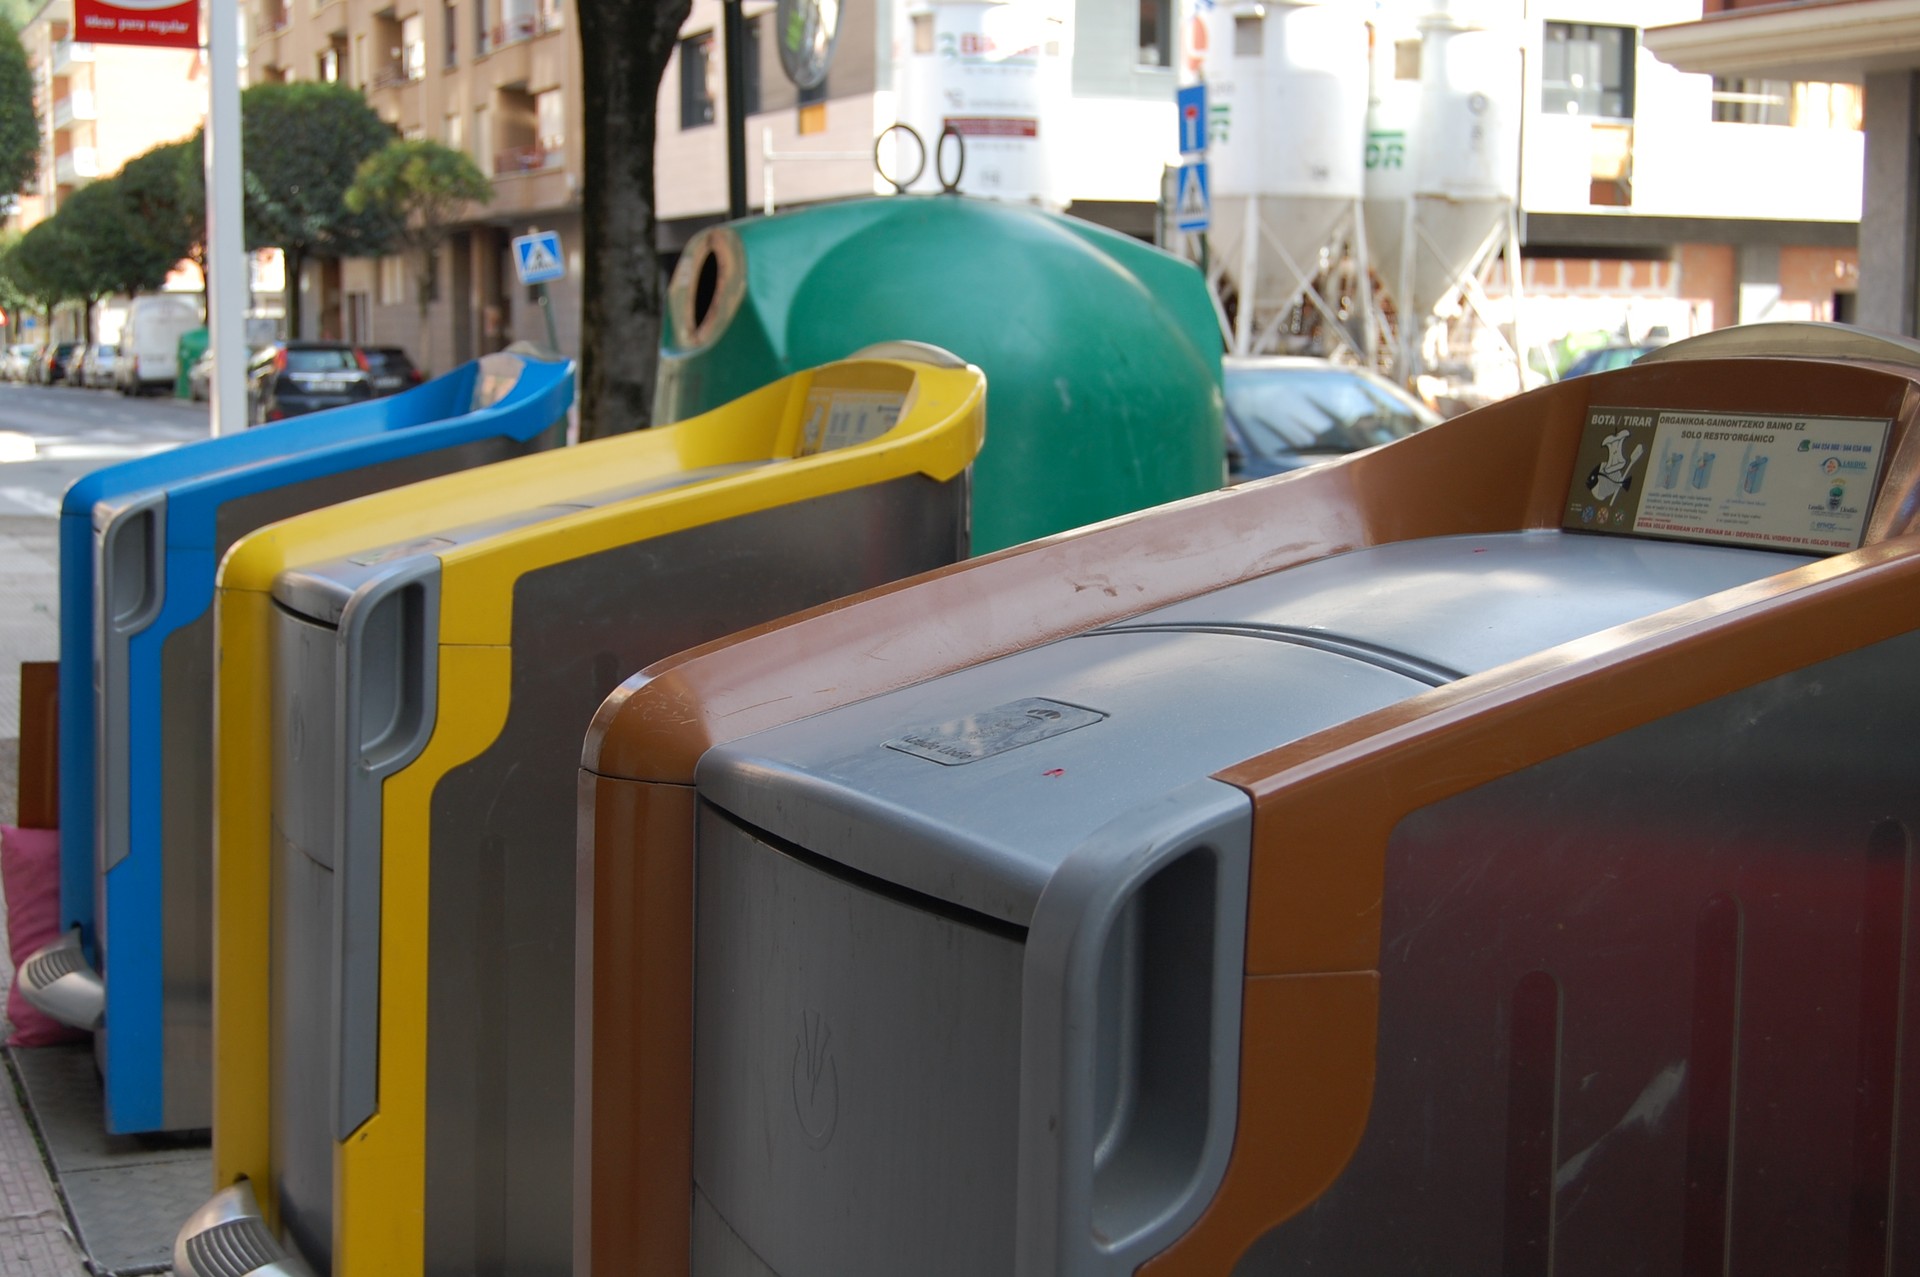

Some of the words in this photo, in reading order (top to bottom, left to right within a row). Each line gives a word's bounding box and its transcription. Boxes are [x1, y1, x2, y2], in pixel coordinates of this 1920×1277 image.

[118, 19, 146, 32] para
[1591, 415, 1617, 425] BOTA
[1617, 416, 1622, 425] /
[1623, 416, 1652, 427] TIRAR
[1660, 416, 1765, 429] ORGANIKOA-GAINONTZEKO
[1766, 421, 1793, 430] BAINO
[1794, 422, 1806, 431] EZ
[1681, 430, 1702, 439] SOLO
[1736, 531, 1762, 540] DEPOSITA
